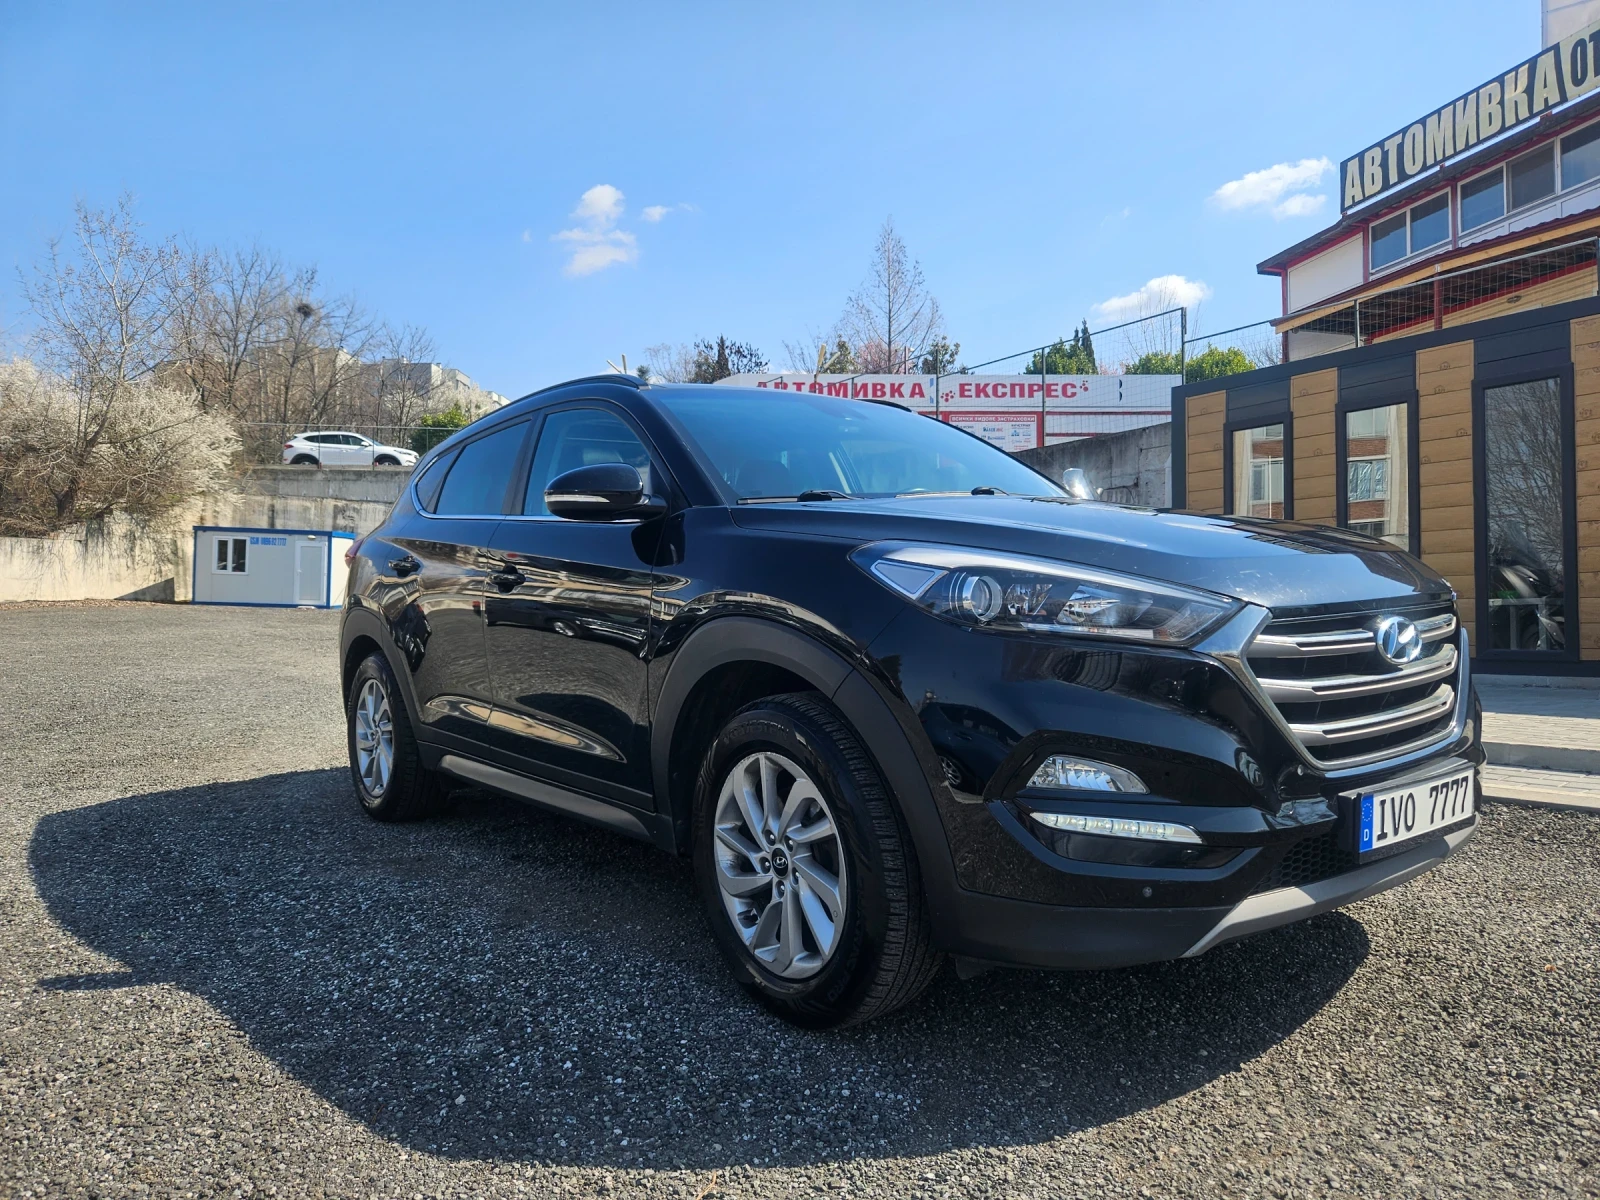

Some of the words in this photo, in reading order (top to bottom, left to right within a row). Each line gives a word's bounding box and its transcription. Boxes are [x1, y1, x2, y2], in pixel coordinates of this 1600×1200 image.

[1344, 49, 1561, 208] АВТОМИВКА
[959, 382, 1077, 399] ЕКСПРЕС
[1376, 792, 1416, 842] IVO
[1429, 775, 1469, 826] 7777
[1363, 828, 1370, 842] D
